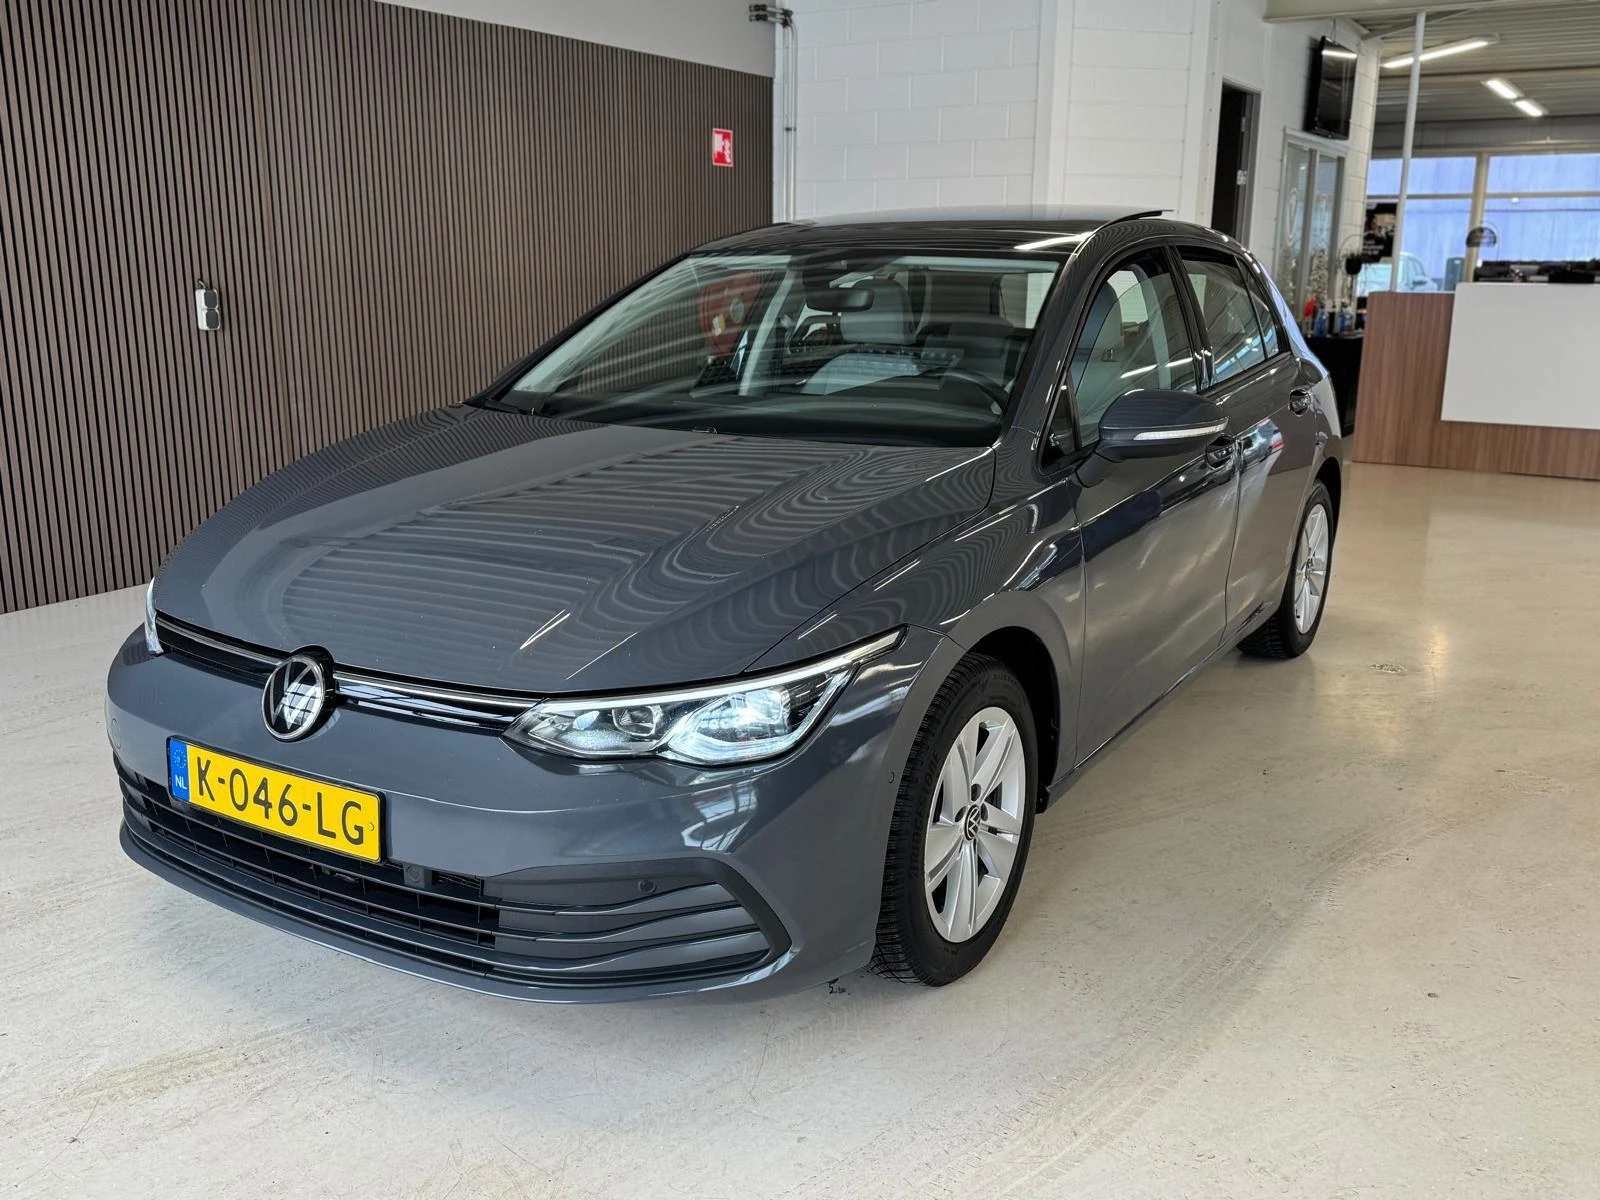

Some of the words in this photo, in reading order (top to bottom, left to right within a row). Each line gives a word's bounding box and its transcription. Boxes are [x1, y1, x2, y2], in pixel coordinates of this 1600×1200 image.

[174, 774, 188, 791] NL
[196, 756, 364, 846] K-046-LG
[908, 751, 942, 880] BRIDGESTONE
